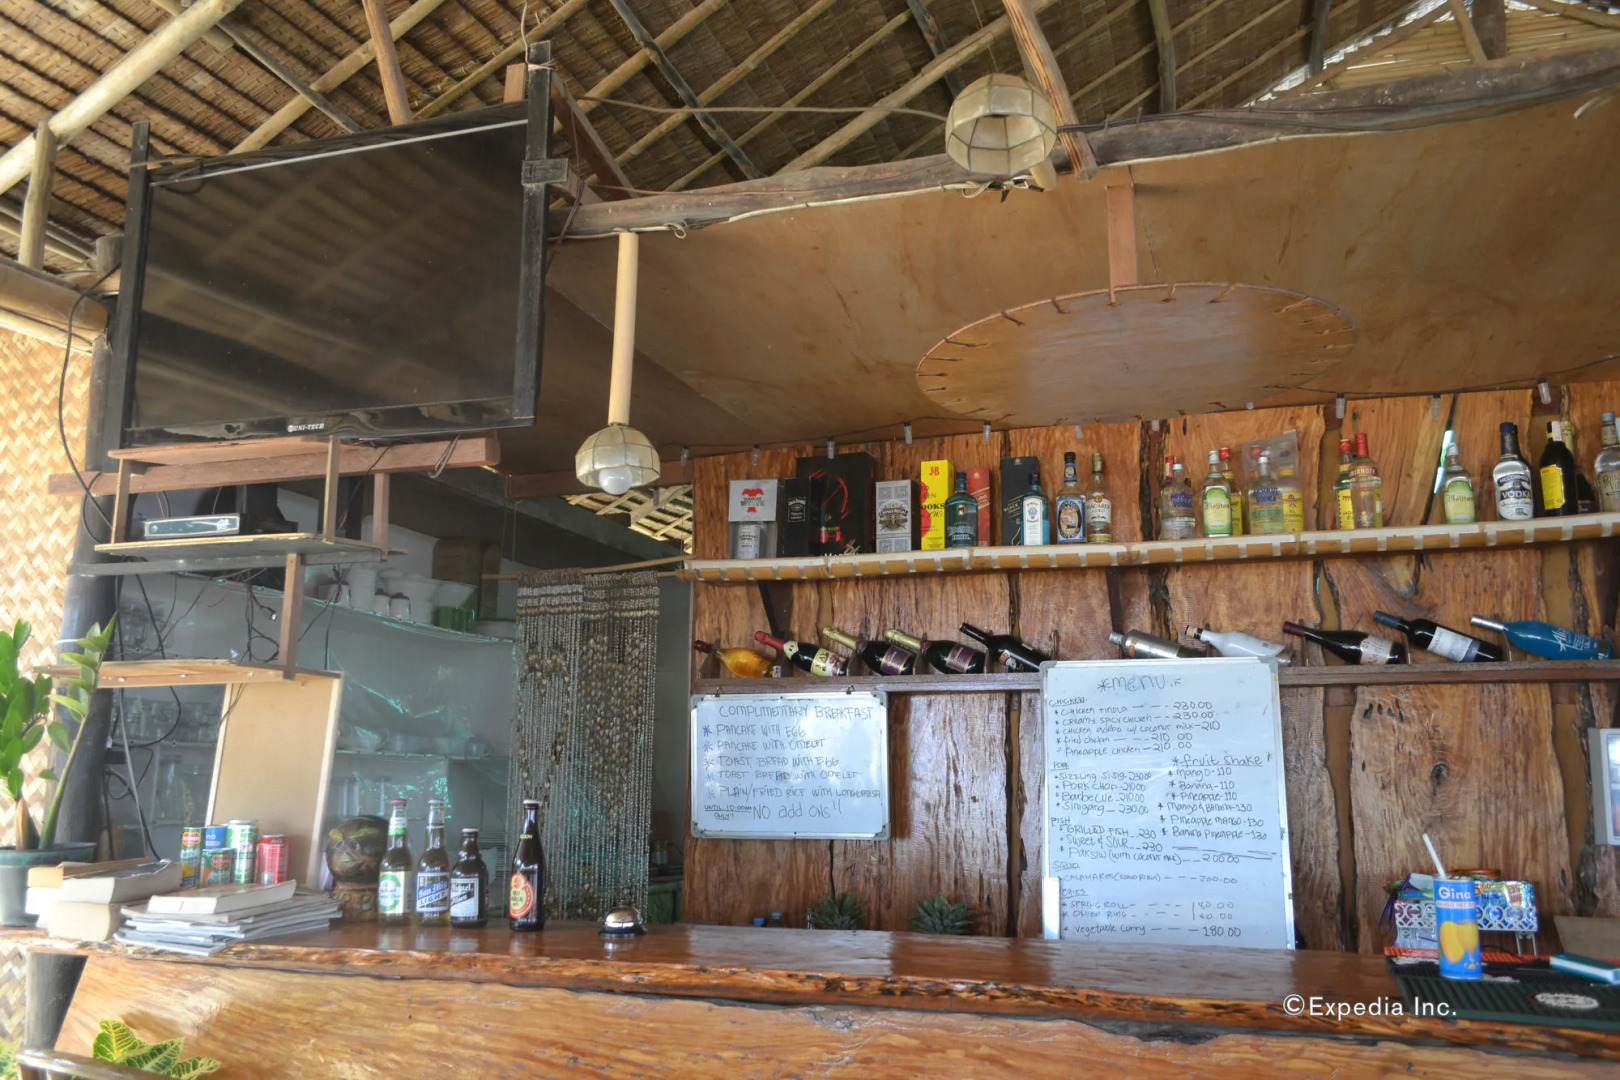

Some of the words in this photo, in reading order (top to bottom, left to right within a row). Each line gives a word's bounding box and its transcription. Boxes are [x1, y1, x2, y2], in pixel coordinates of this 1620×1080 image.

[815, 706, 873, 720] BREAKFAST
[716, 724, 757, 736] PANCAKE
[717, 740, 758, 751] PANCAKE
[789, 739, 825, 751] OMELET
[756, 756, 788, 768] BREAD
[718, 770, 751, 779] TOAST
[704, 803, 723, 812] UNTIL
[753, 803, 770, 820] NO
[1438, 886, 1472, 899] Gina
